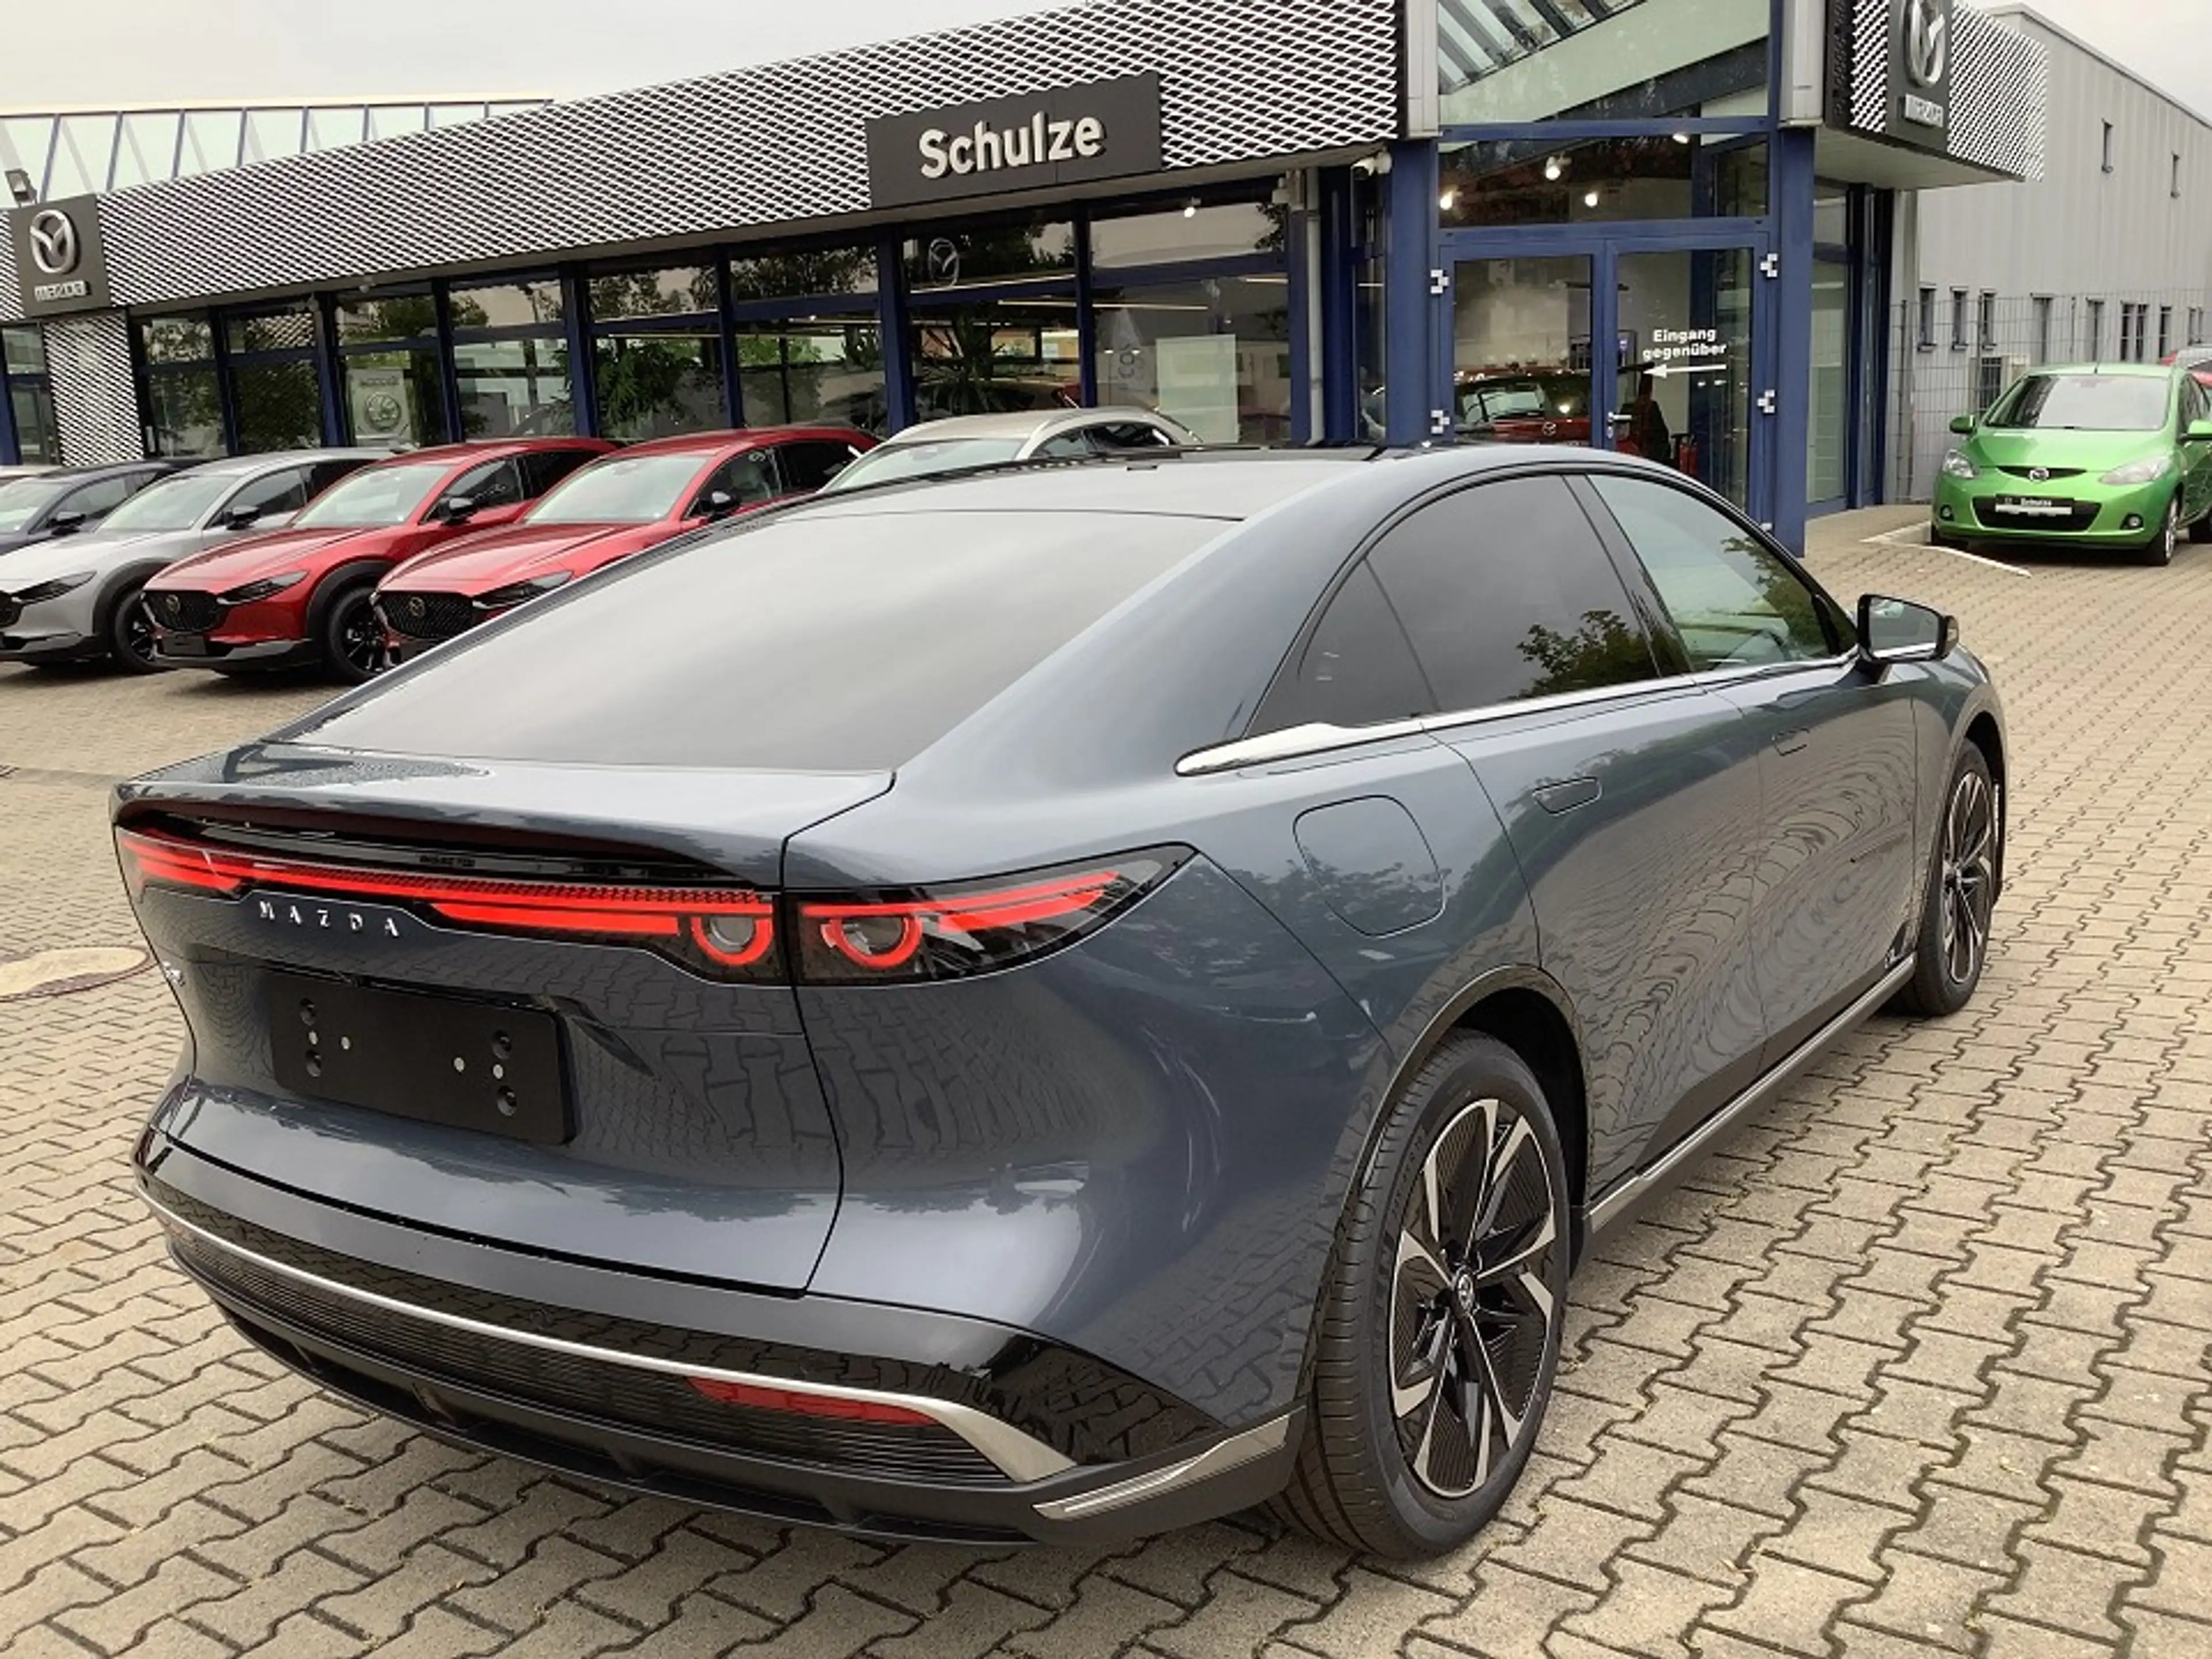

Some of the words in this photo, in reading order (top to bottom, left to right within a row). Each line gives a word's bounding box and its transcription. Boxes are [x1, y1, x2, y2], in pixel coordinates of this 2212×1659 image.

[919, 111, 1105, 179] Schulze
[1653, 329, 1716, 344] Eingang
[1642, 343, 1727, 361] gegenüber
[259, 900, 400, 937] MAZDA
